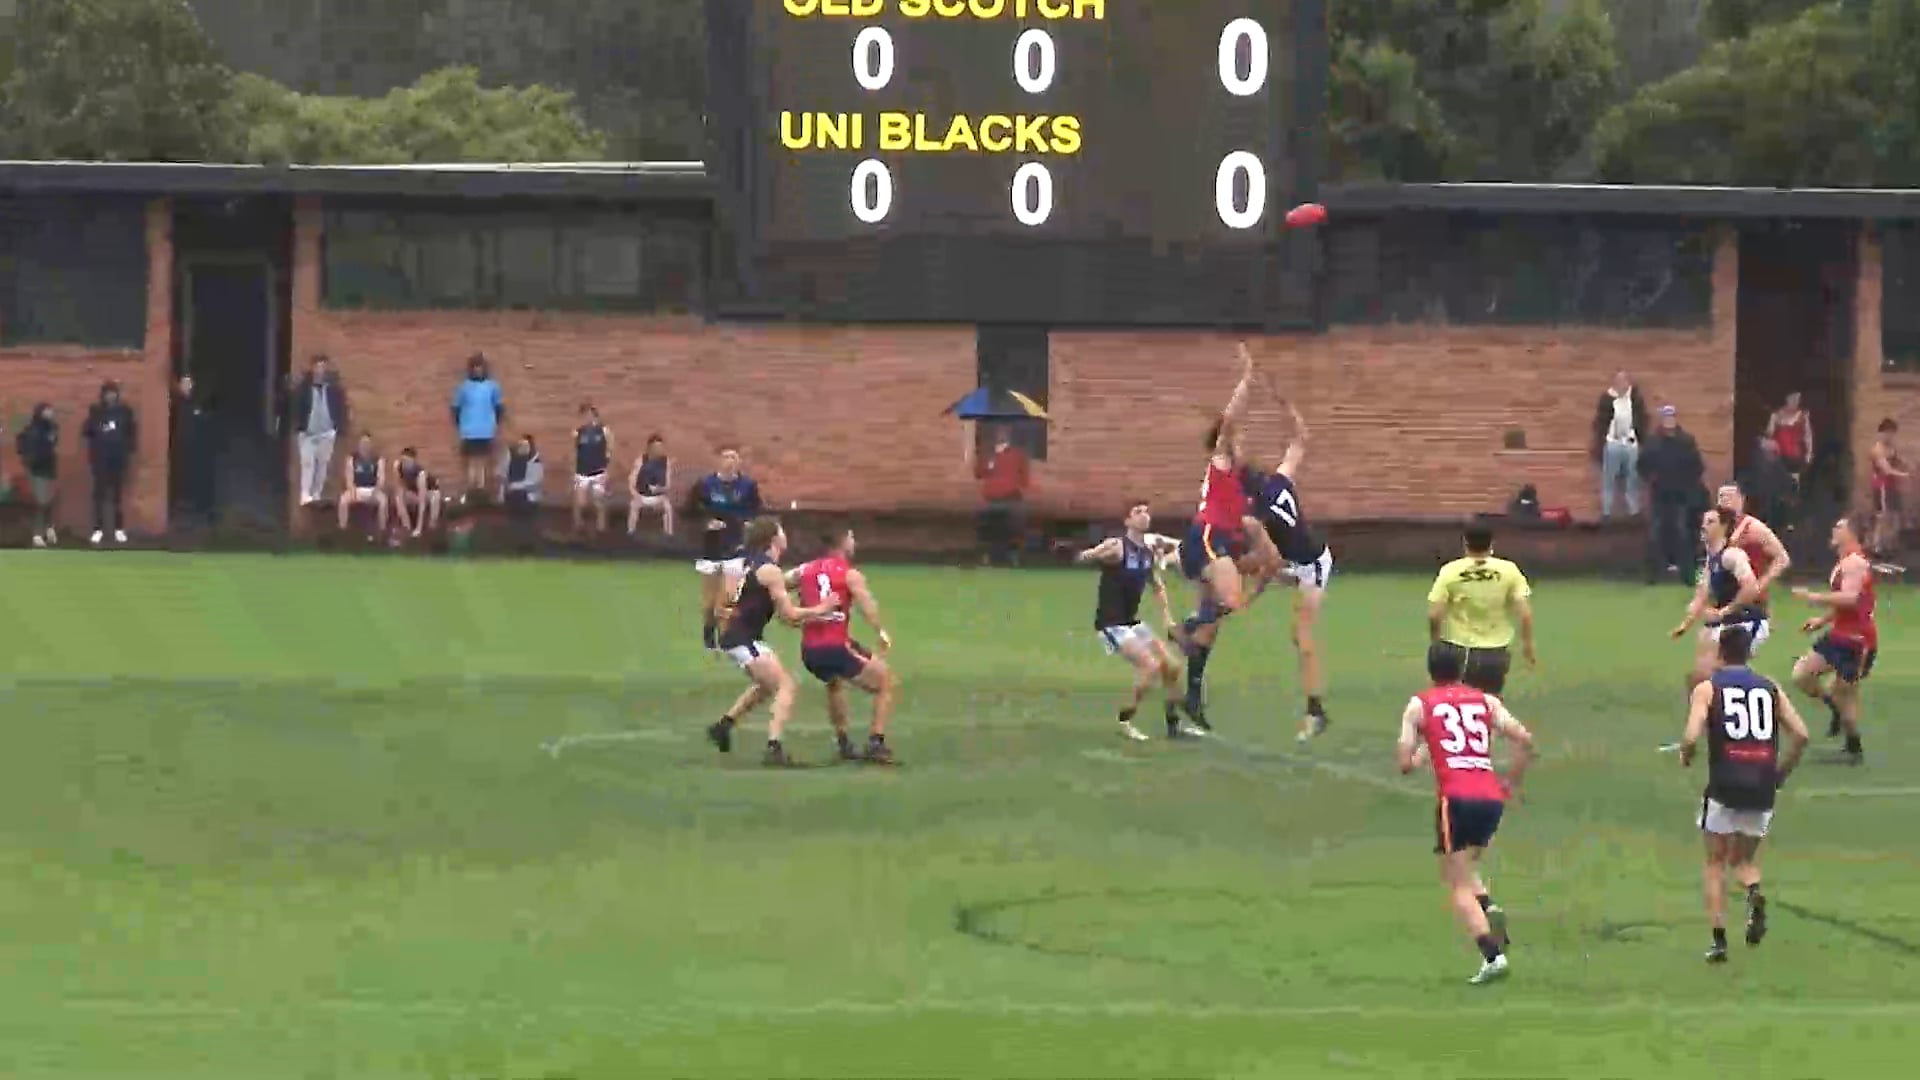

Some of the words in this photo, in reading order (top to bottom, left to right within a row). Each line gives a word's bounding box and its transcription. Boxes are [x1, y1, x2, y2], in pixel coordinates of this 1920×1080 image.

[851, 26, 895, 91] 0
[1013, 28, 1056, 94] 0
[1218, 17, 1269, 97] 0
[780, 111, 863, 150] UNI
[878, 113, 1082, 154] BLACKS
[850, 158, 893, 224] 0
[1011, 161, 1054, 226] 0
[1215, 150, 1267, 229] 0
[1432, 702, 1489, 754] 35
[1722, 687, 1773, 740] 50
